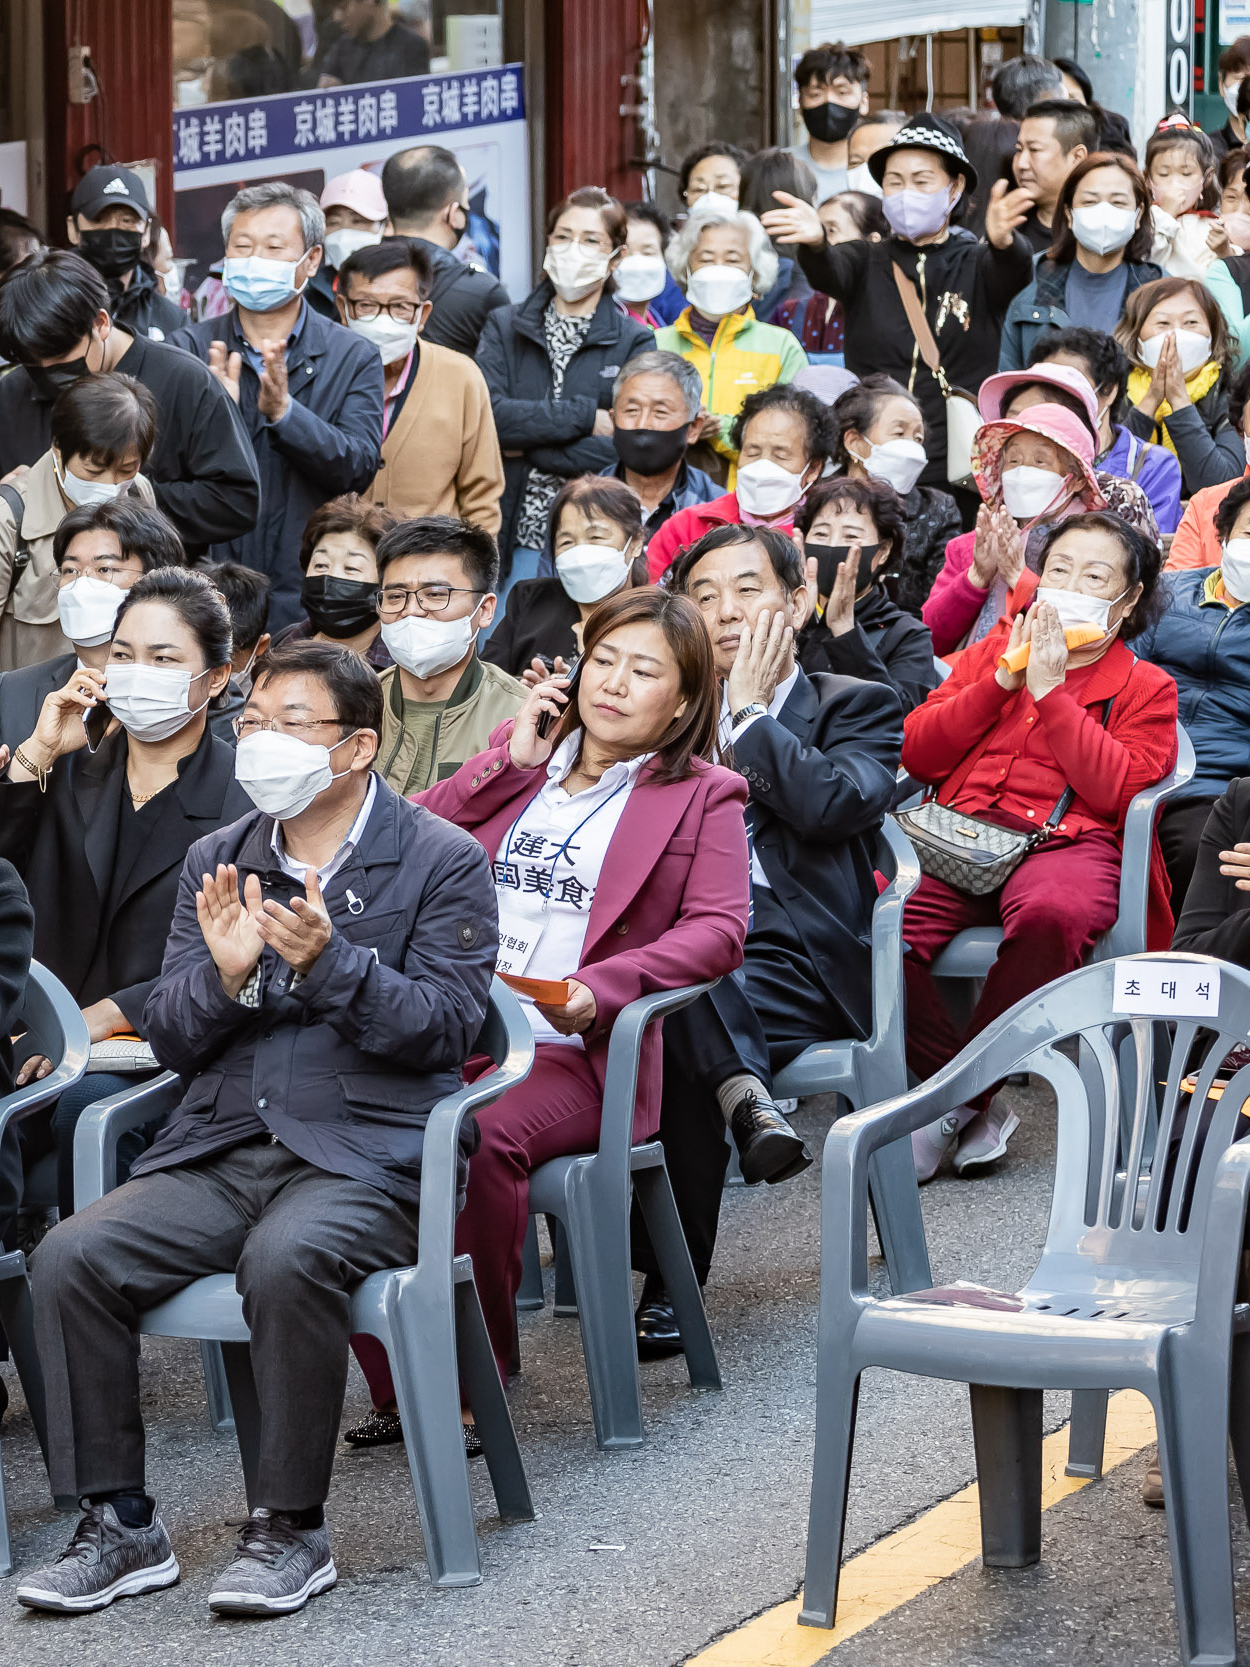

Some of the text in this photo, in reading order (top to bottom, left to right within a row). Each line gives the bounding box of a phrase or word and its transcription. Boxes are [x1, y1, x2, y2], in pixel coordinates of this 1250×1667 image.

[294, 89, 398, 148] 京城羊肉串
[422, 71, 518, 128] 京城羊肉串
[174, 108, 268, 166] 城羊肉串
